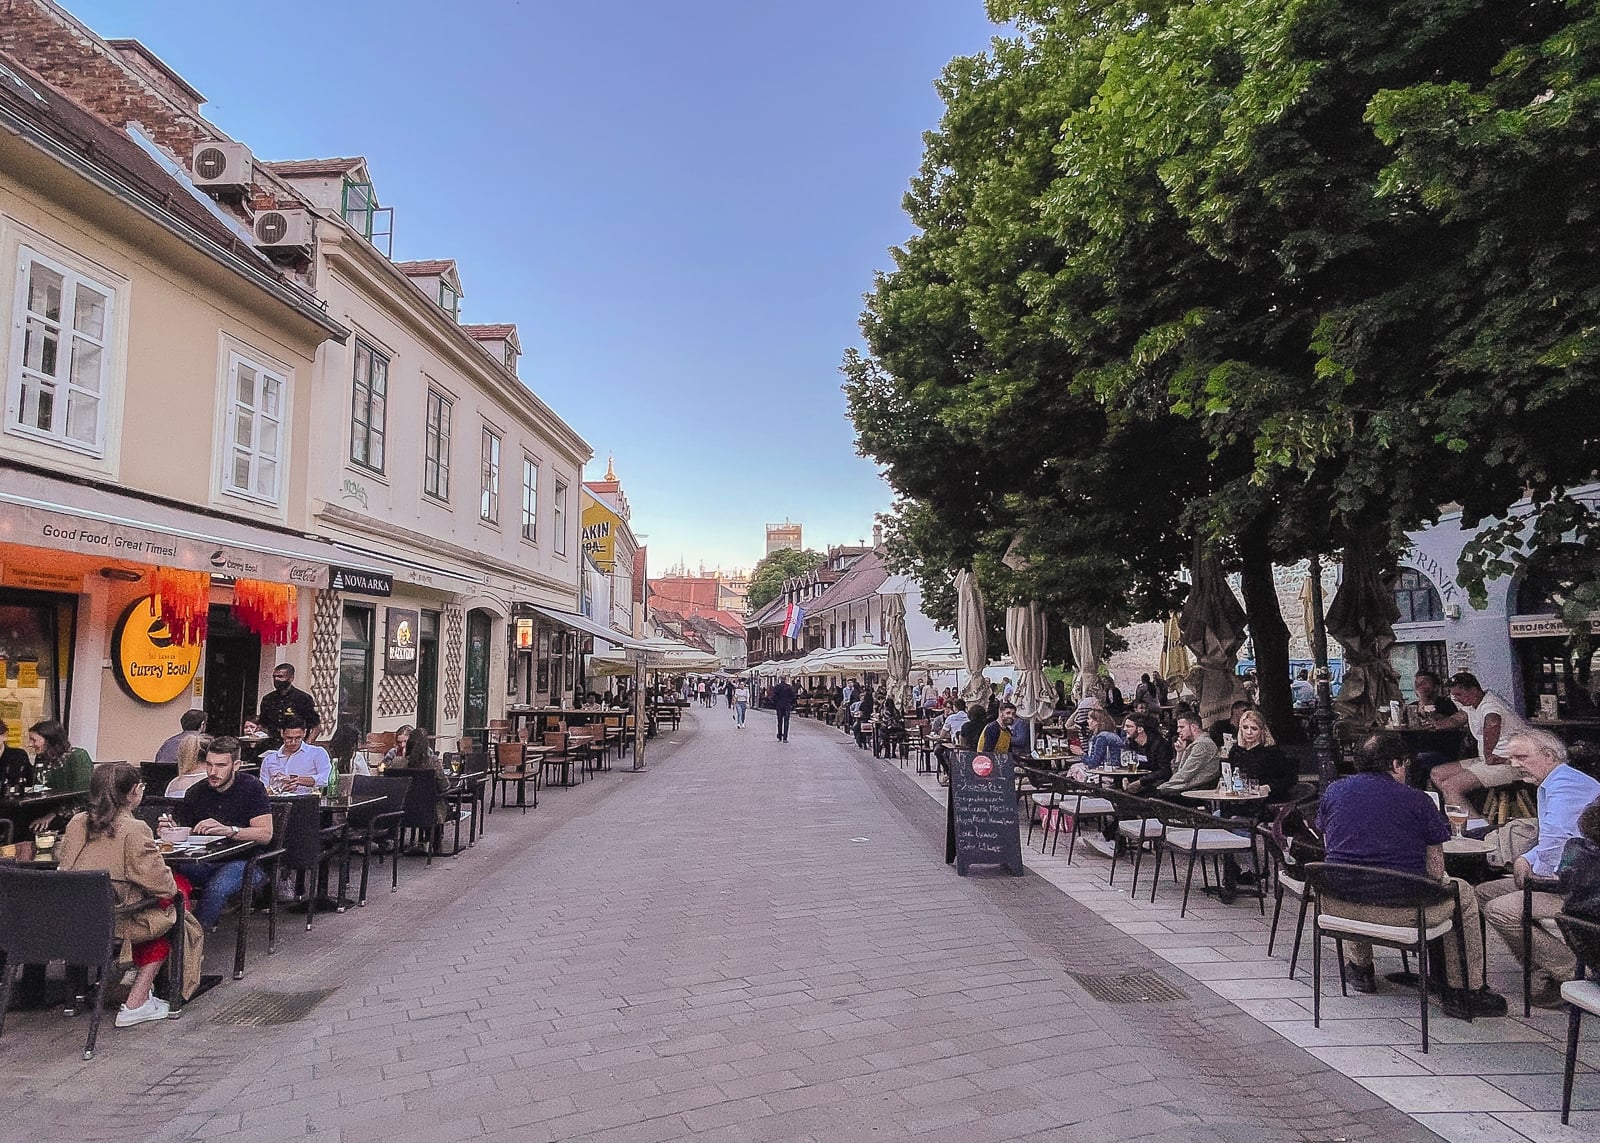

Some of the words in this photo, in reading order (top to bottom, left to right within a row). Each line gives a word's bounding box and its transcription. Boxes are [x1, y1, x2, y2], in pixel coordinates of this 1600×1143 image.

[43, 525, 77, 540] Good
[79, 531, 111, 547] Food,
[114, 537, 142, 552] Great
[146, 542, 177, 557] Times!
[227, 560, 244, 572] Curry
[344, 574, 367, 589] NOVA
[367, 578, 390, 592] ARKA
[130, 661, 164, 679] Curry
[166, 661, 191, 676] Bowl
